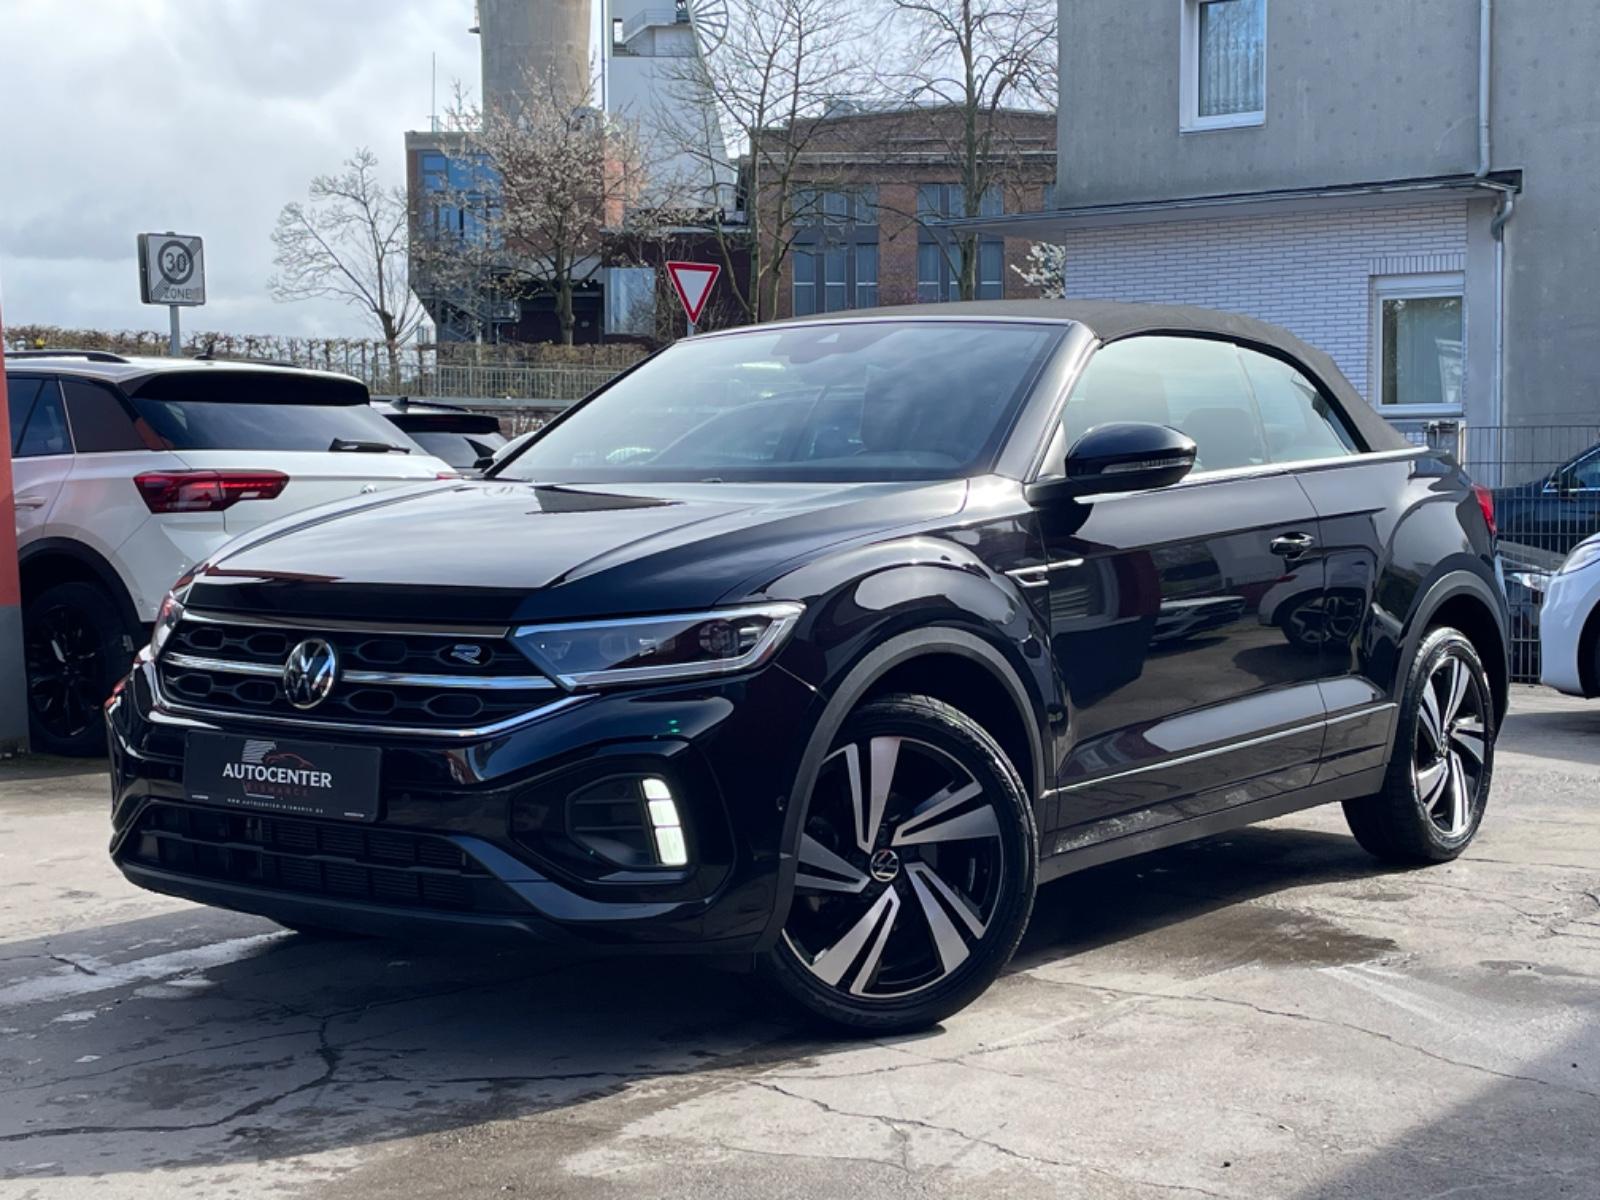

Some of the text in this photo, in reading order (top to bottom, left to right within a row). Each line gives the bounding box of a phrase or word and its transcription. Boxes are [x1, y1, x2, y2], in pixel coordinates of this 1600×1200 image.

[165, 252, 187, 273] 30
[164, 287, 192, 299] ZONE
[222, 762, 332, 788] AUTOCENTER
